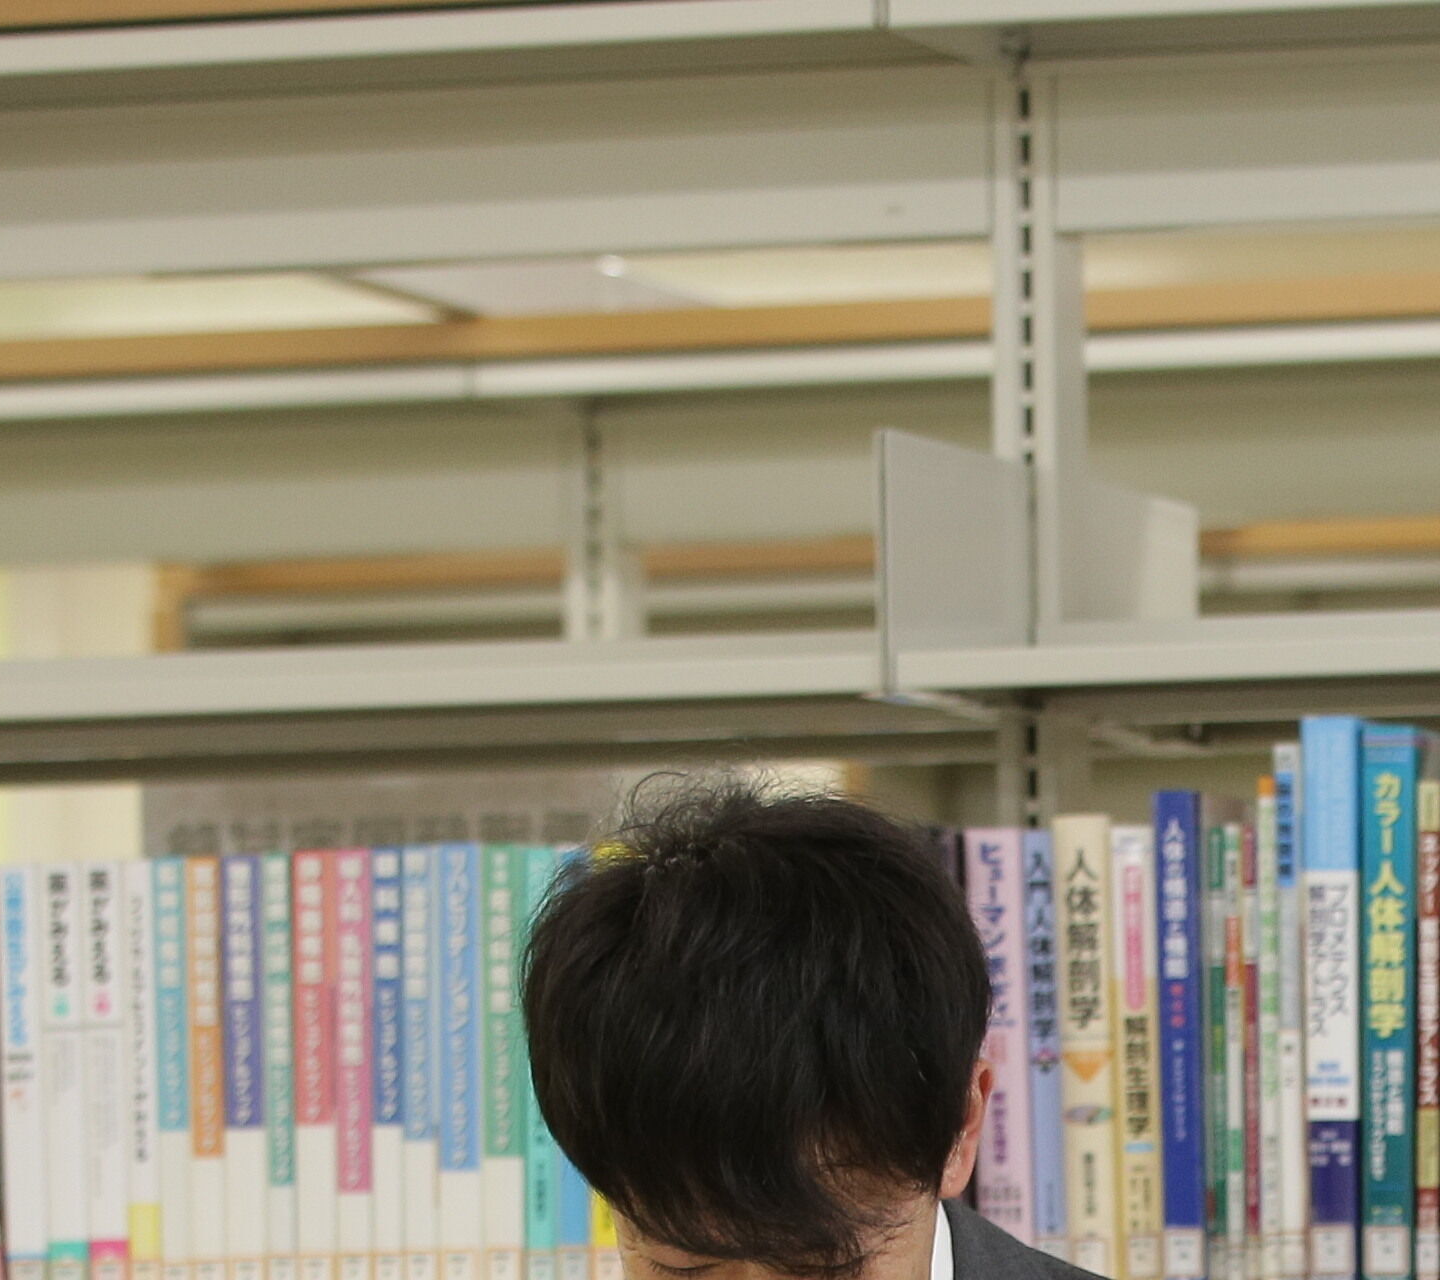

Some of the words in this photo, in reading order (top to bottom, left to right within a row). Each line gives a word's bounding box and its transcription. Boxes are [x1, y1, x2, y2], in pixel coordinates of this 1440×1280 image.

[1064, 848, 1104, 1032] 人体解剖学
[1368, 774, 1407, 1040] カラー人体解剖学
